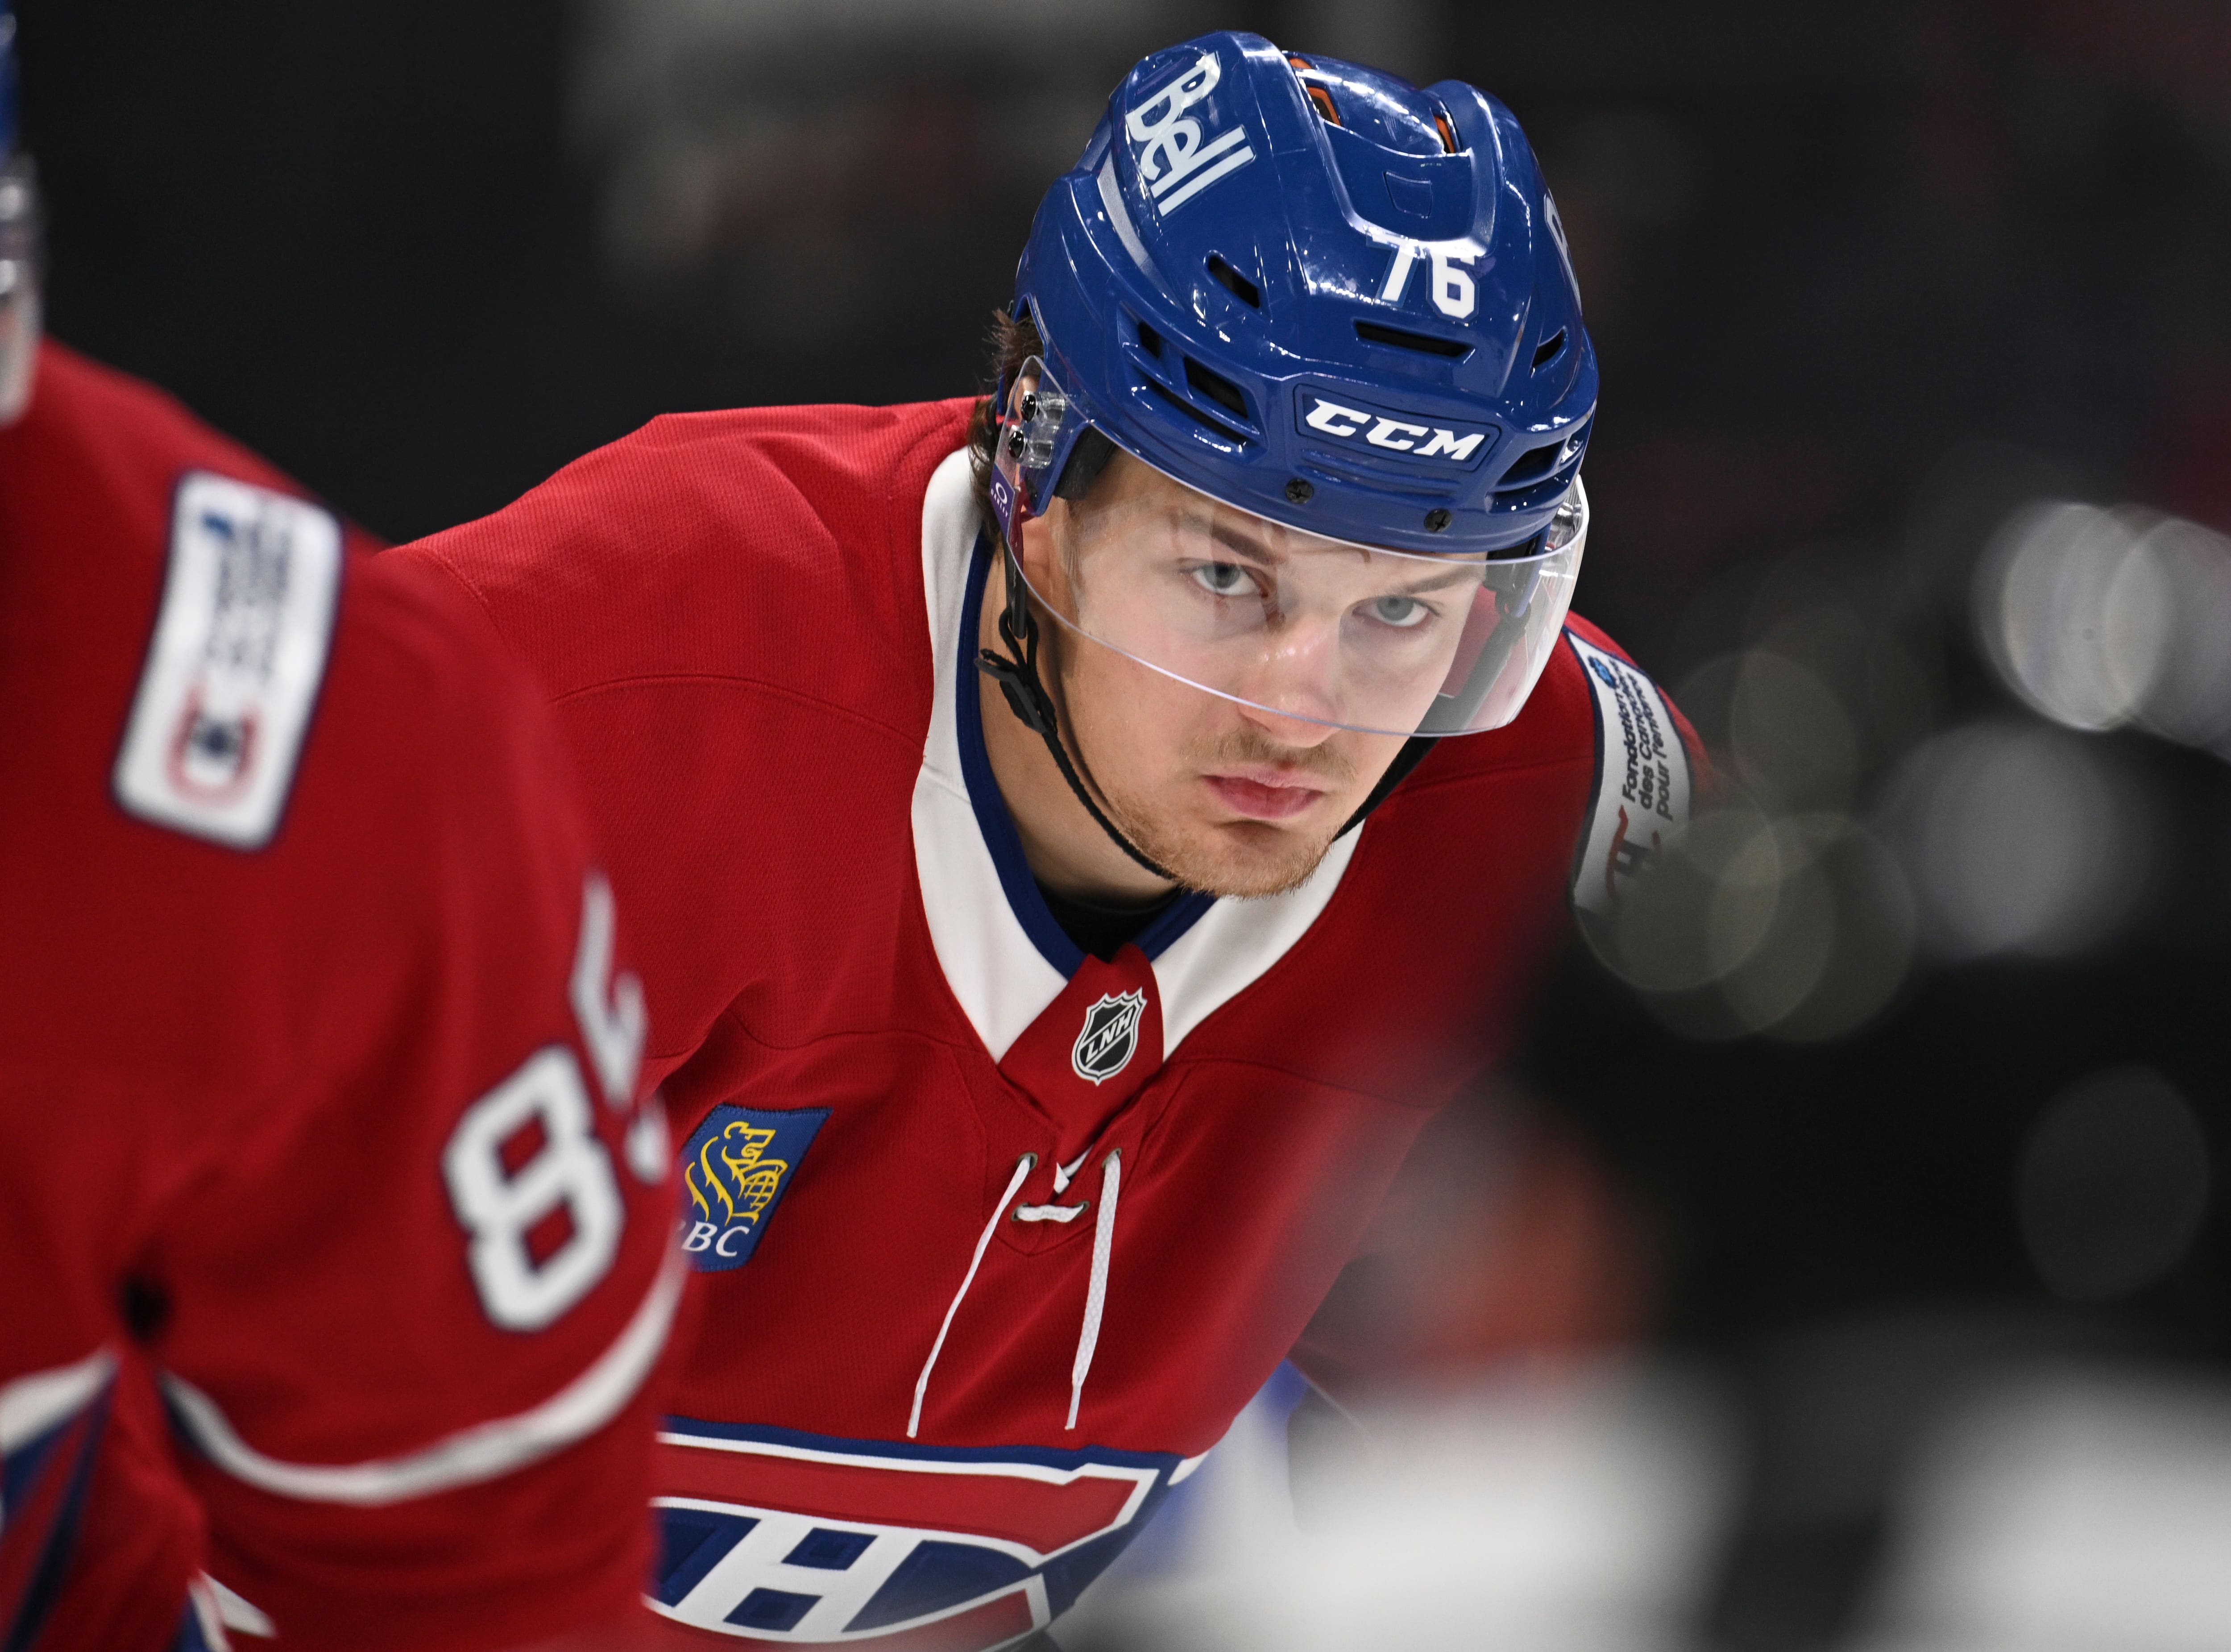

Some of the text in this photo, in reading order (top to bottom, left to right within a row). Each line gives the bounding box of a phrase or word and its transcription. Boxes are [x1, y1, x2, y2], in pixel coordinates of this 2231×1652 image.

[1125, 51, 1254, 217] Bell
[1366, 231, 1475, 319] 76
[1306, 398, 1485, 460] CCM
[1615, 692, 1638, 802] Fondation
[1638, 765, 1654, 809] des
[1656, 760, 1673, 821] pour
[1086, 1007, 1133, 1064] LNH
[679, 1220, 750, 1257] BC
